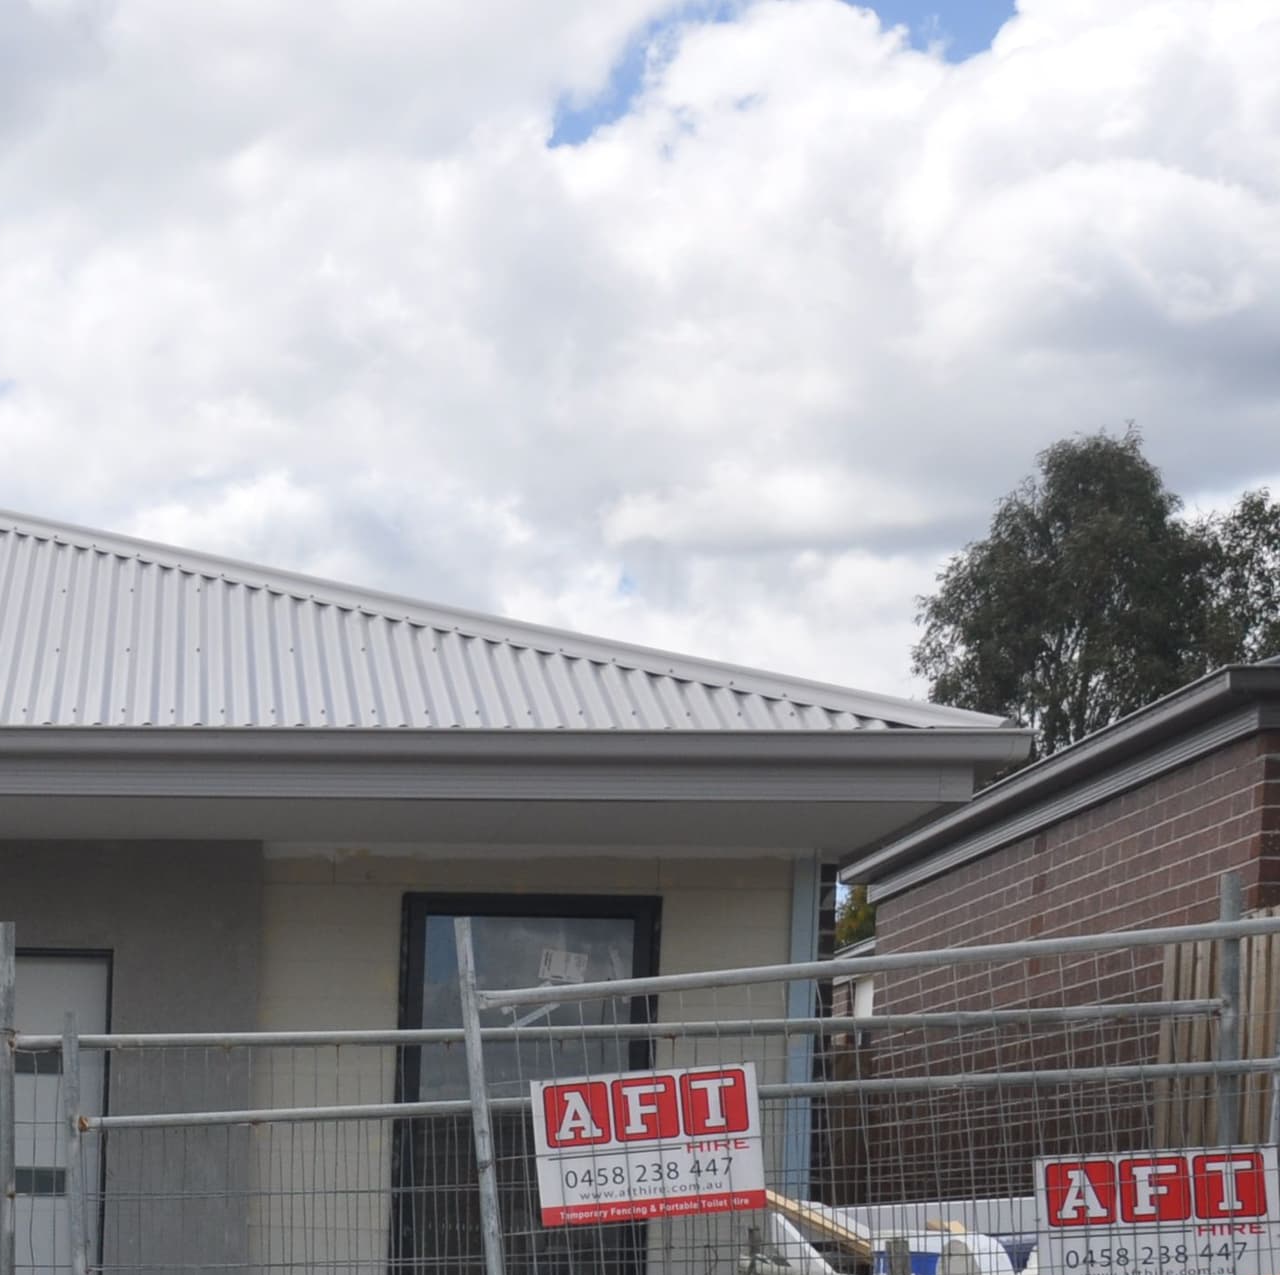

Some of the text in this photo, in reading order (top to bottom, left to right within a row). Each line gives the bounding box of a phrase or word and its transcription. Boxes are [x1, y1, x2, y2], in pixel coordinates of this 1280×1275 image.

[555, 1077, 735, 1141] AFT
[686, 1138, 750, 1153] HIRE
[565, 1156, 733, 1189] 0458 238 447
[579, 1181, 723, 1200] www.afthire.com.au
[1056, 1160, 1253, 1220] AFT
[560, 1209, 608, 1220] Temporary
[610, 1205, 647, 1215] Fencing
[659, 1201, 699, 1212] Portable
[701, 1198, 728, 1208] Toilet
[1197, 1223, 1266, 1237] HIRE
[1066, 1242, 1247, 1269] 0458 238 447
